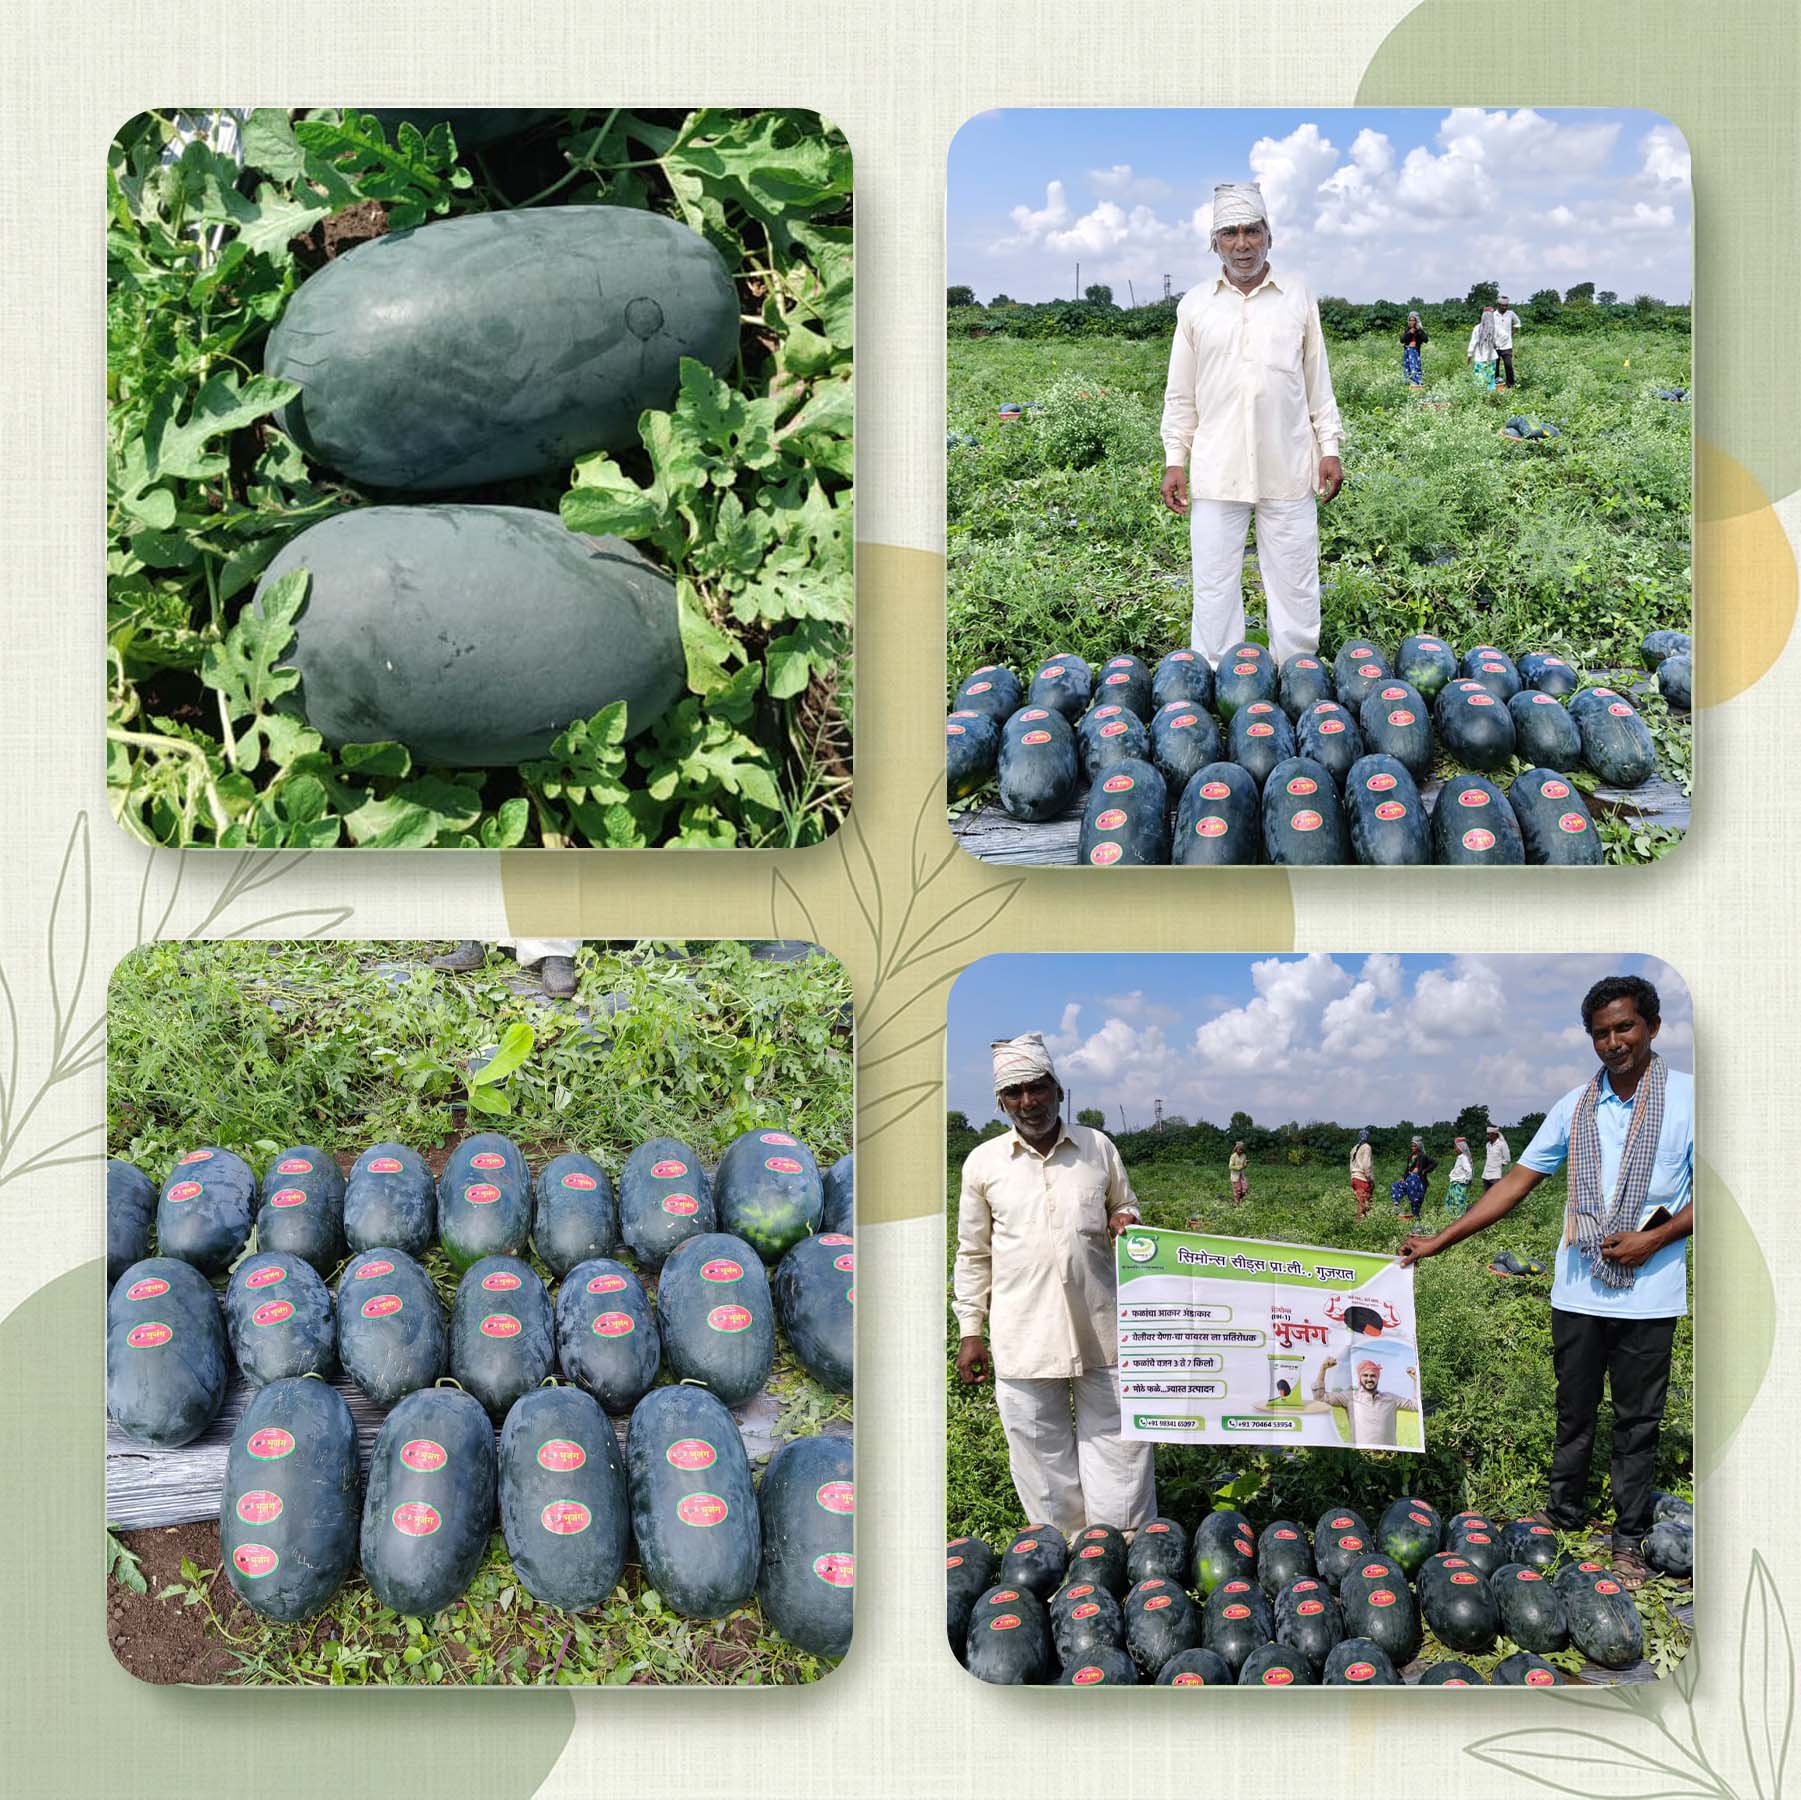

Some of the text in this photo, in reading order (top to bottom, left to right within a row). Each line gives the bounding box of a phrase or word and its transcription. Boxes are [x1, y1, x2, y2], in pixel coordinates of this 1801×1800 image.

[1178, 1248, 1226, 1267] सिमोन्स
[1231, 1254, 1265, 1274] सीड्स
[1315, 1266, 1355, 1281] गुजरात
[1158, 1308, 1180, 1318] आकार
[1272, 1318, 1329, 1348] भुजंग
[1193, 1357, 1214, 1368] किलो
